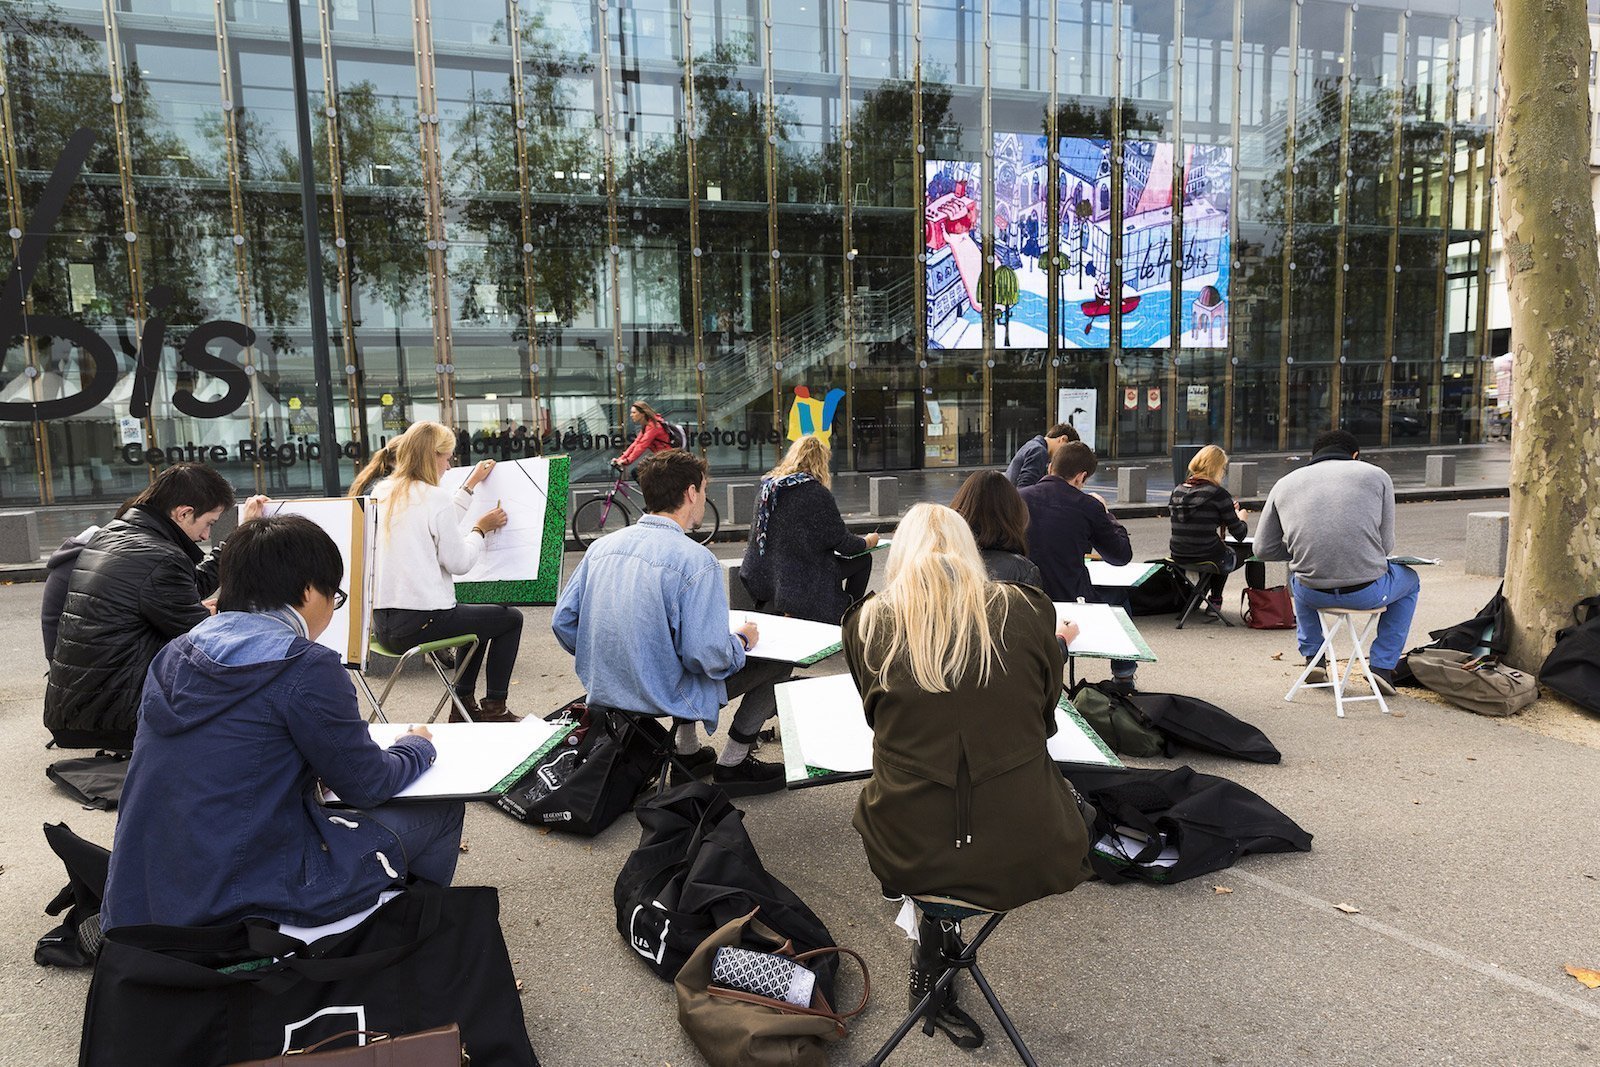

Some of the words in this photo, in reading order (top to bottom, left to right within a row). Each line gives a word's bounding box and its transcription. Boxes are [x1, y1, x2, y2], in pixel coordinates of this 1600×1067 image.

[0, 127, 256, 420] bis
[122, 441, 228, 466] Centre
[685, 427, 781, 451] retagne
